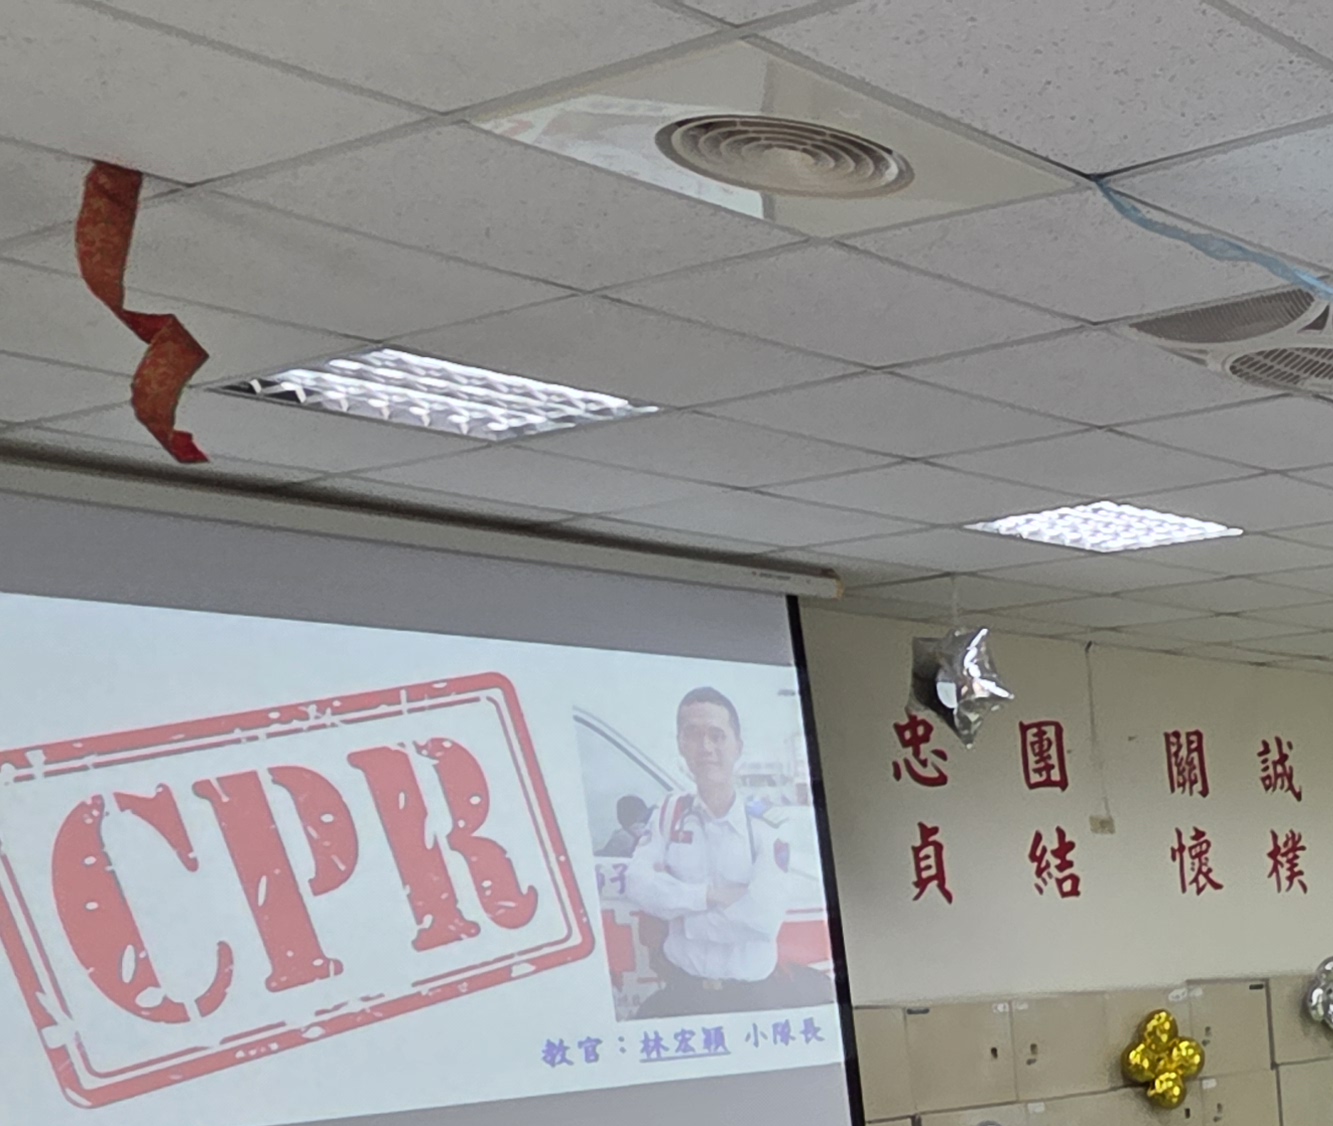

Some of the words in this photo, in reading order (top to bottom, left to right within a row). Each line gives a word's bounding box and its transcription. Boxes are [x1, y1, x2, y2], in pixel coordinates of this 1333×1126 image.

[52, 734, 541, 1025] CPR
[891, 714, 953, 905] 忠貞
[1019, 720, 1081, 899] 團結
[1163, 729, 1224, 896] 關懷
[1257, 736, 1308, 895] 誠樸
[745, 1016, 825, 1048] 小隊長
